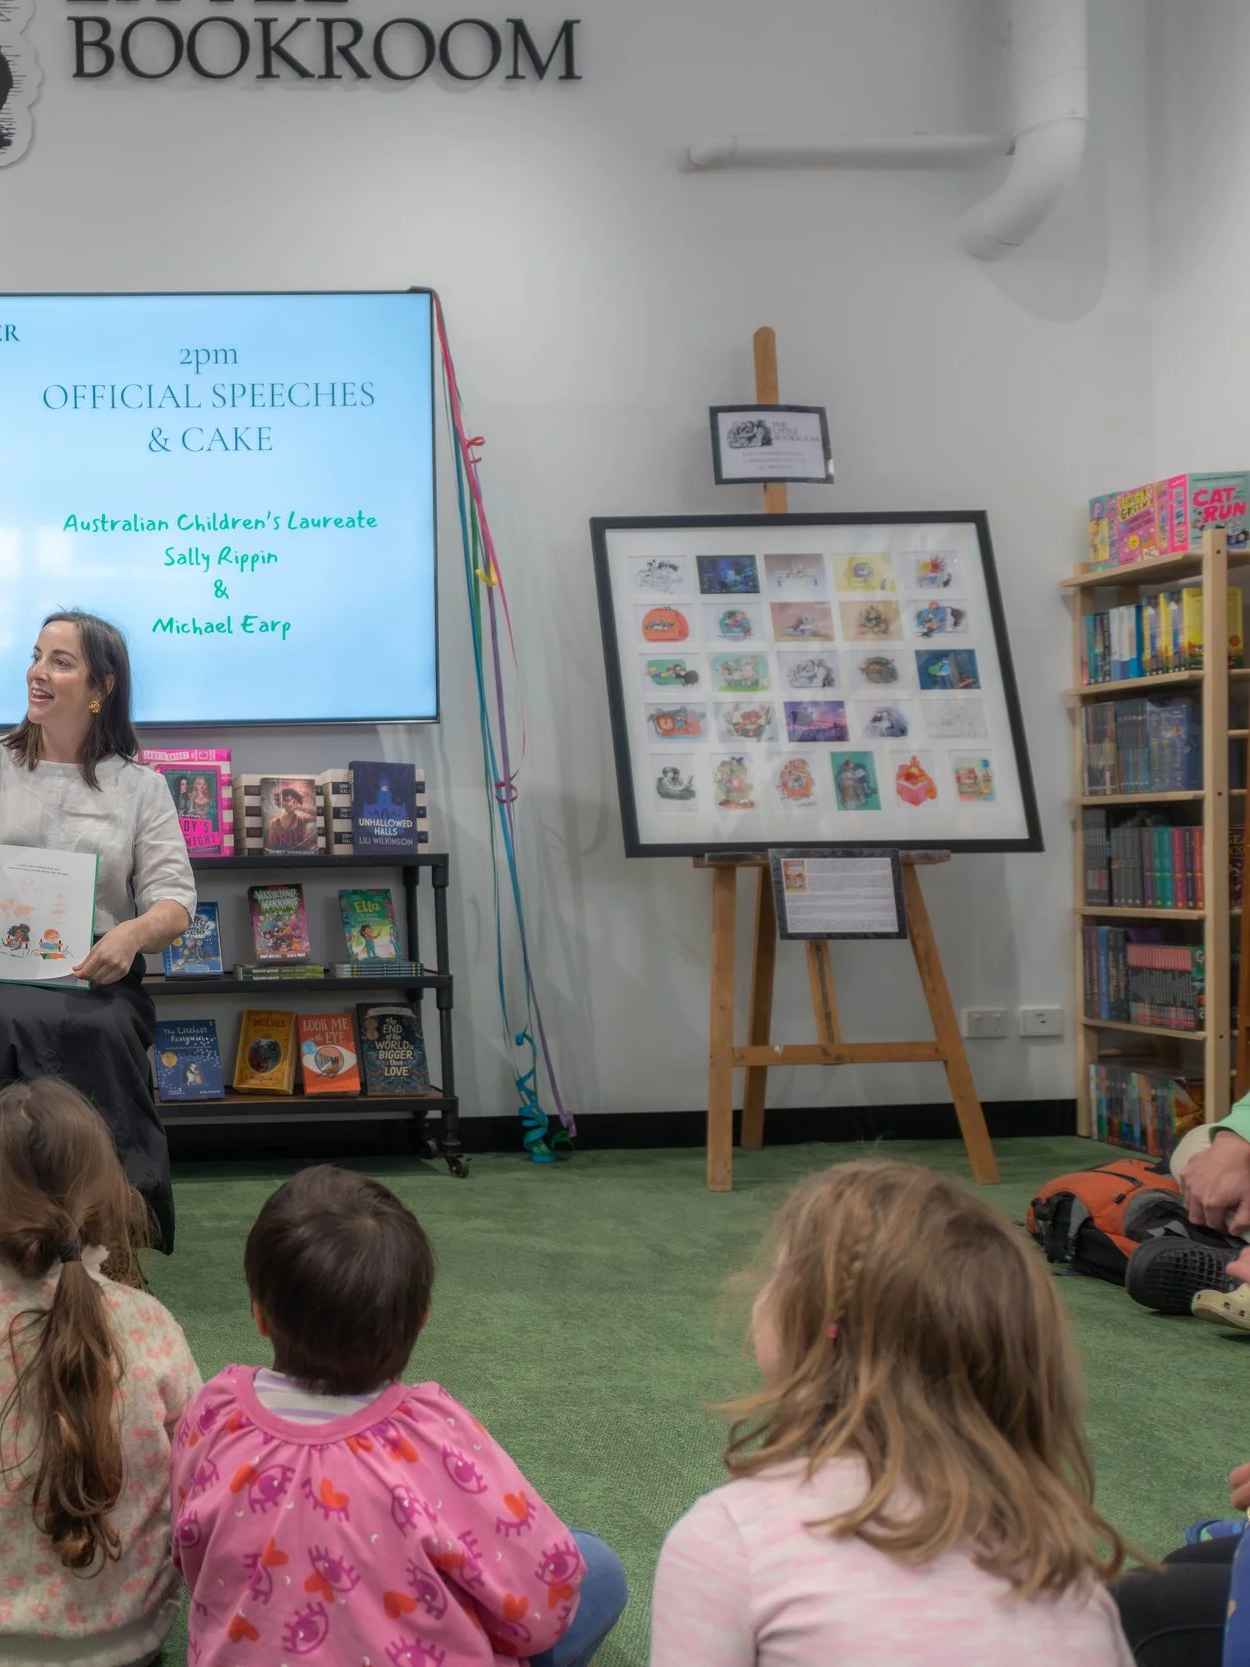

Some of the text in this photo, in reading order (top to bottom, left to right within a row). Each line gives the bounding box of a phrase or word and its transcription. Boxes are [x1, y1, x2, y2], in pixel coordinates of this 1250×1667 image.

[67, 16, 583, 81] BOOKROOM
[179, 346, 239, 375] 2pm
[42, 381, 375, 411] OFFICIAL SPEECHES
[147, 426, 274, 453] & CAKE
[1193, 487, 1236, 506] CAT
[1203, 502, 1247, 524] RUN
[62, 510, 379, 533] Australian Children's Laureate
[163, 546, 279, 573] Sally Rippin
[213, 579, 229, 600] &
[151, 614, 292, 640] Michael Earp
[358, 817, 414, 829] UNHALLOWED
[374, 826, 398, 837] HALLS
[185, 834, 216, 848] NIGHT
[359, 836, 414, 847] LILI WILKINSON
[354, 900, 381, 913] Ella
[253, 1017, 287, 1028] WOLVES
[302, 1017, 349, 1032] LOOK ME
[382, 1024, 403, 1034] END
[325, 1031, 346, 1044] EYE
[374, 1041, 409, 1051] WORLD
[378, 1050, 414, 1060] BIGGER
[384, 1066, 410, 1076] LOVE
